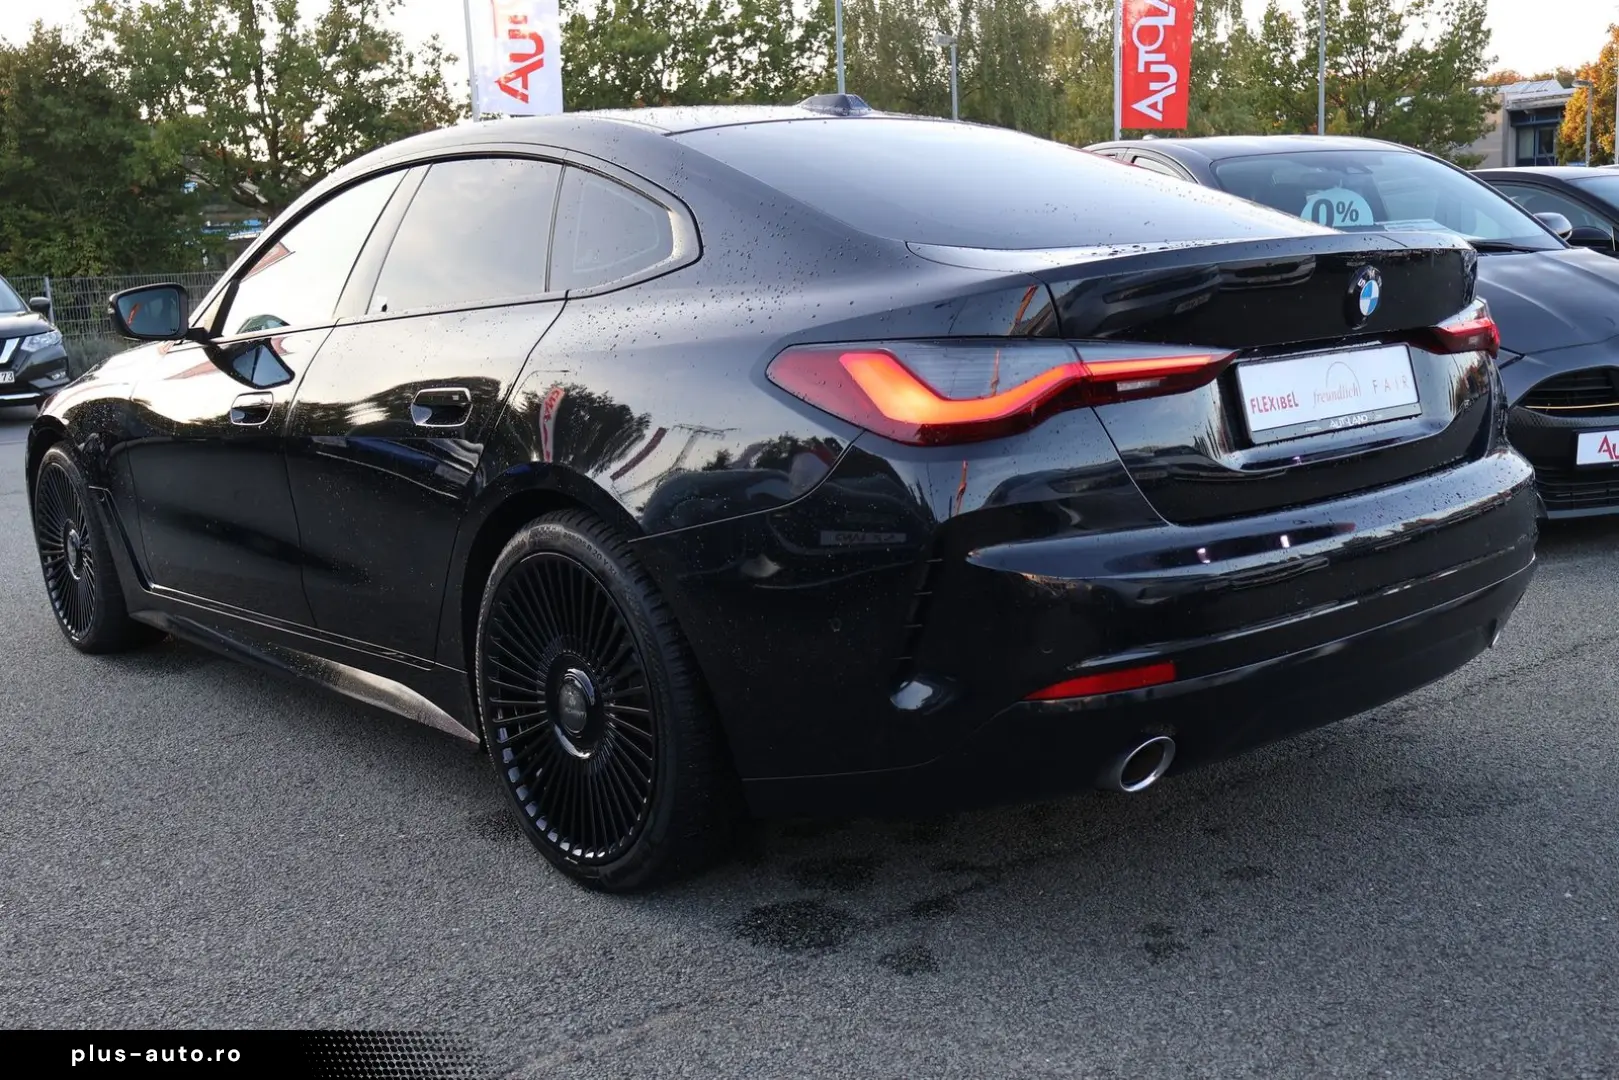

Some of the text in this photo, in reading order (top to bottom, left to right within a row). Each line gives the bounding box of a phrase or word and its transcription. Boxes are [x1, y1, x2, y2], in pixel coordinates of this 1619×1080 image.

[1311, 198, 1360, 228] 0%
[1250, 391, 1299, 414] FLEXIBEL
[1313, 381, 1359, 408] freundlich
